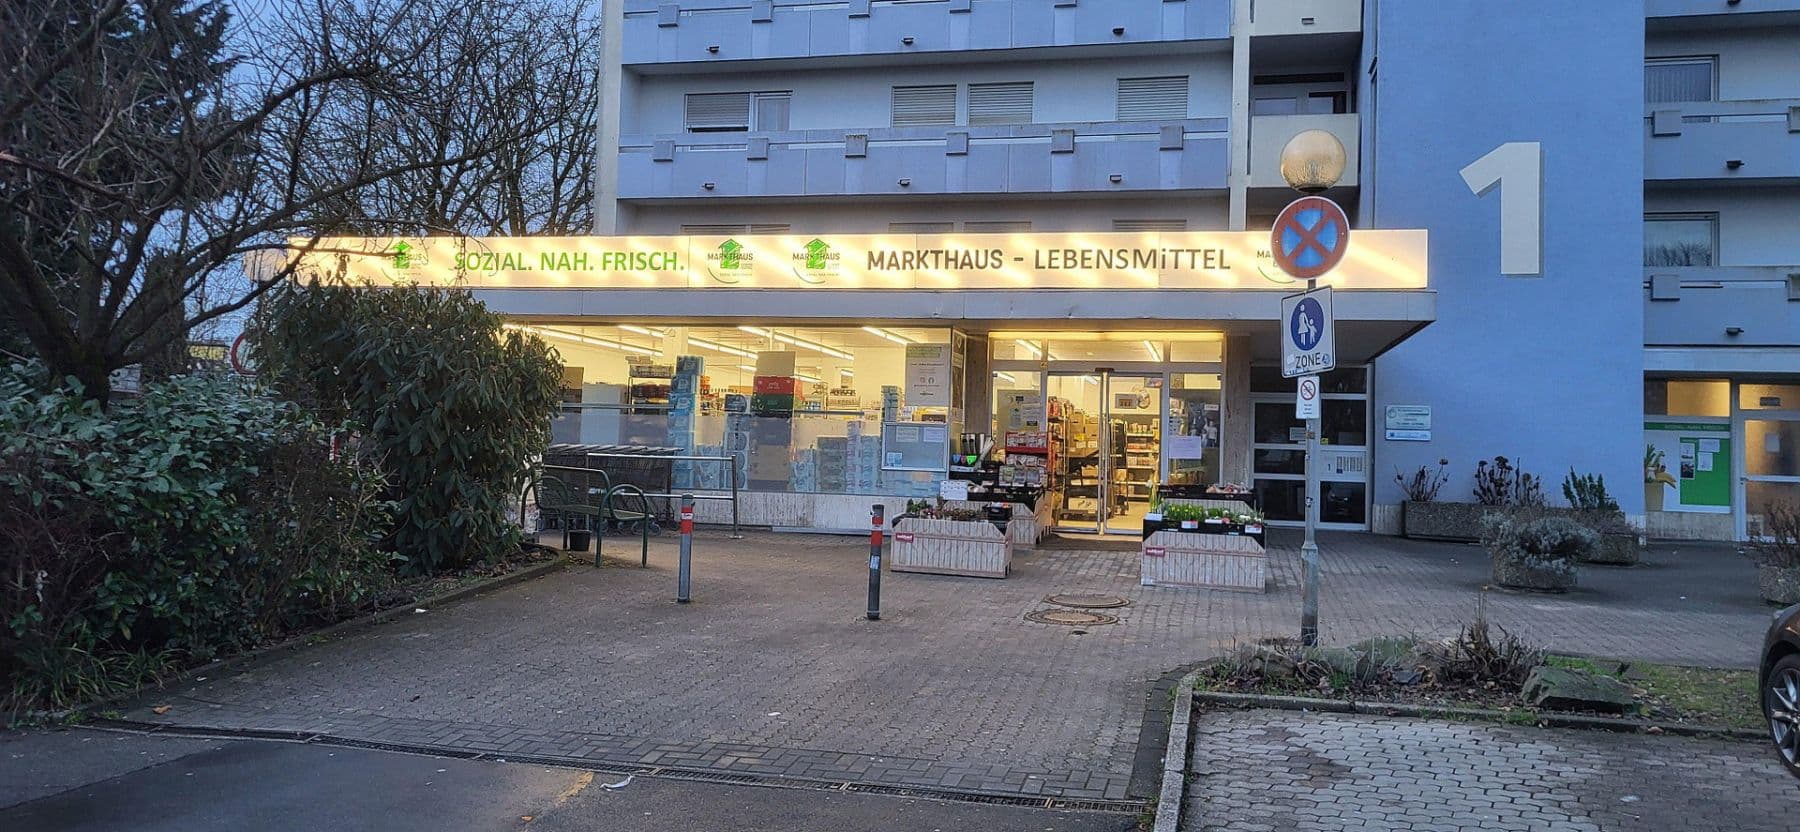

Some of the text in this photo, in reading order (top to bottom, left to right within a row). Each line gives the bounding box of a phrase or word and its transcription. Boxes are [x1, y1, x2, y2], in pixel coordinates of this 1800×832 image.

[1459, 141, 1540, 275] 1
[454, 251, 685, 271] SOZIAL. NAH. FRISCH.
[867, 249, 1004, 271] MARKTHAUS
[1295, 352, 1321, 369] ZONE
